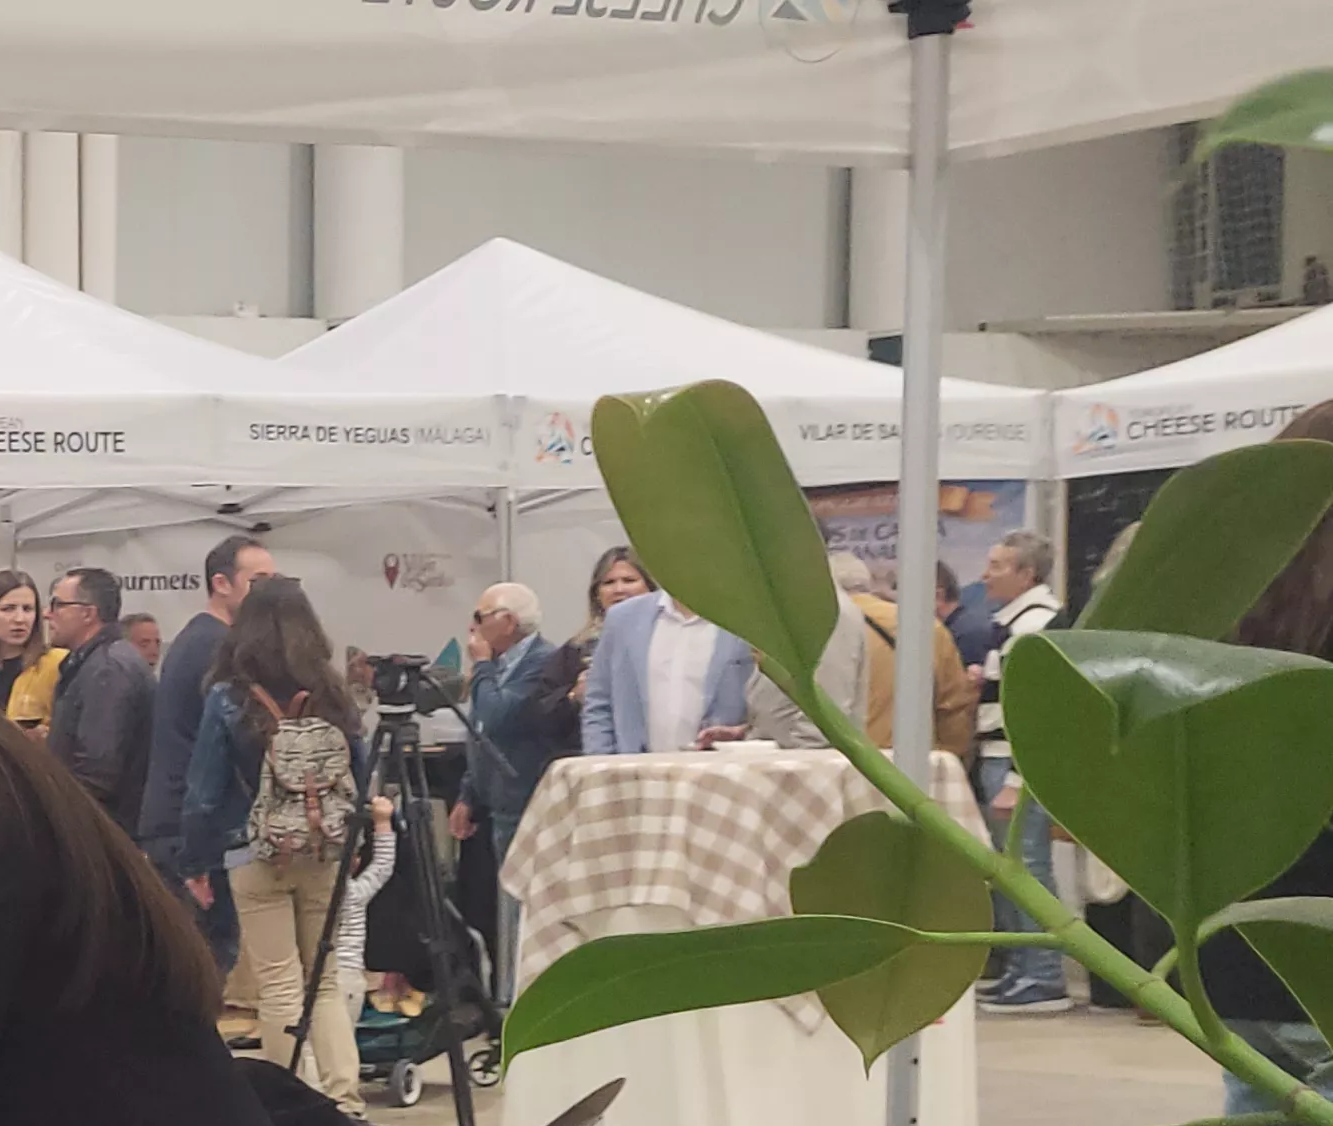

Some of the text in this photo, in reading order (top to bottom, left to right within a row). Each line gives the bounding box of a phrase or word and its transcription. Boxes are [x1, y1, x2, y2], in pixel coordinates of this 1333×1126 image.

[249, 423, 311, 442] SIERRA
[315, 426, 339, 443] DE
[343, 427, 411, 444] YEGUAS
[851, 423, 875, 441] DE
[1126, 412, 1217, 441] CHEESE
[53, 431, 126, 453] ROUTE
